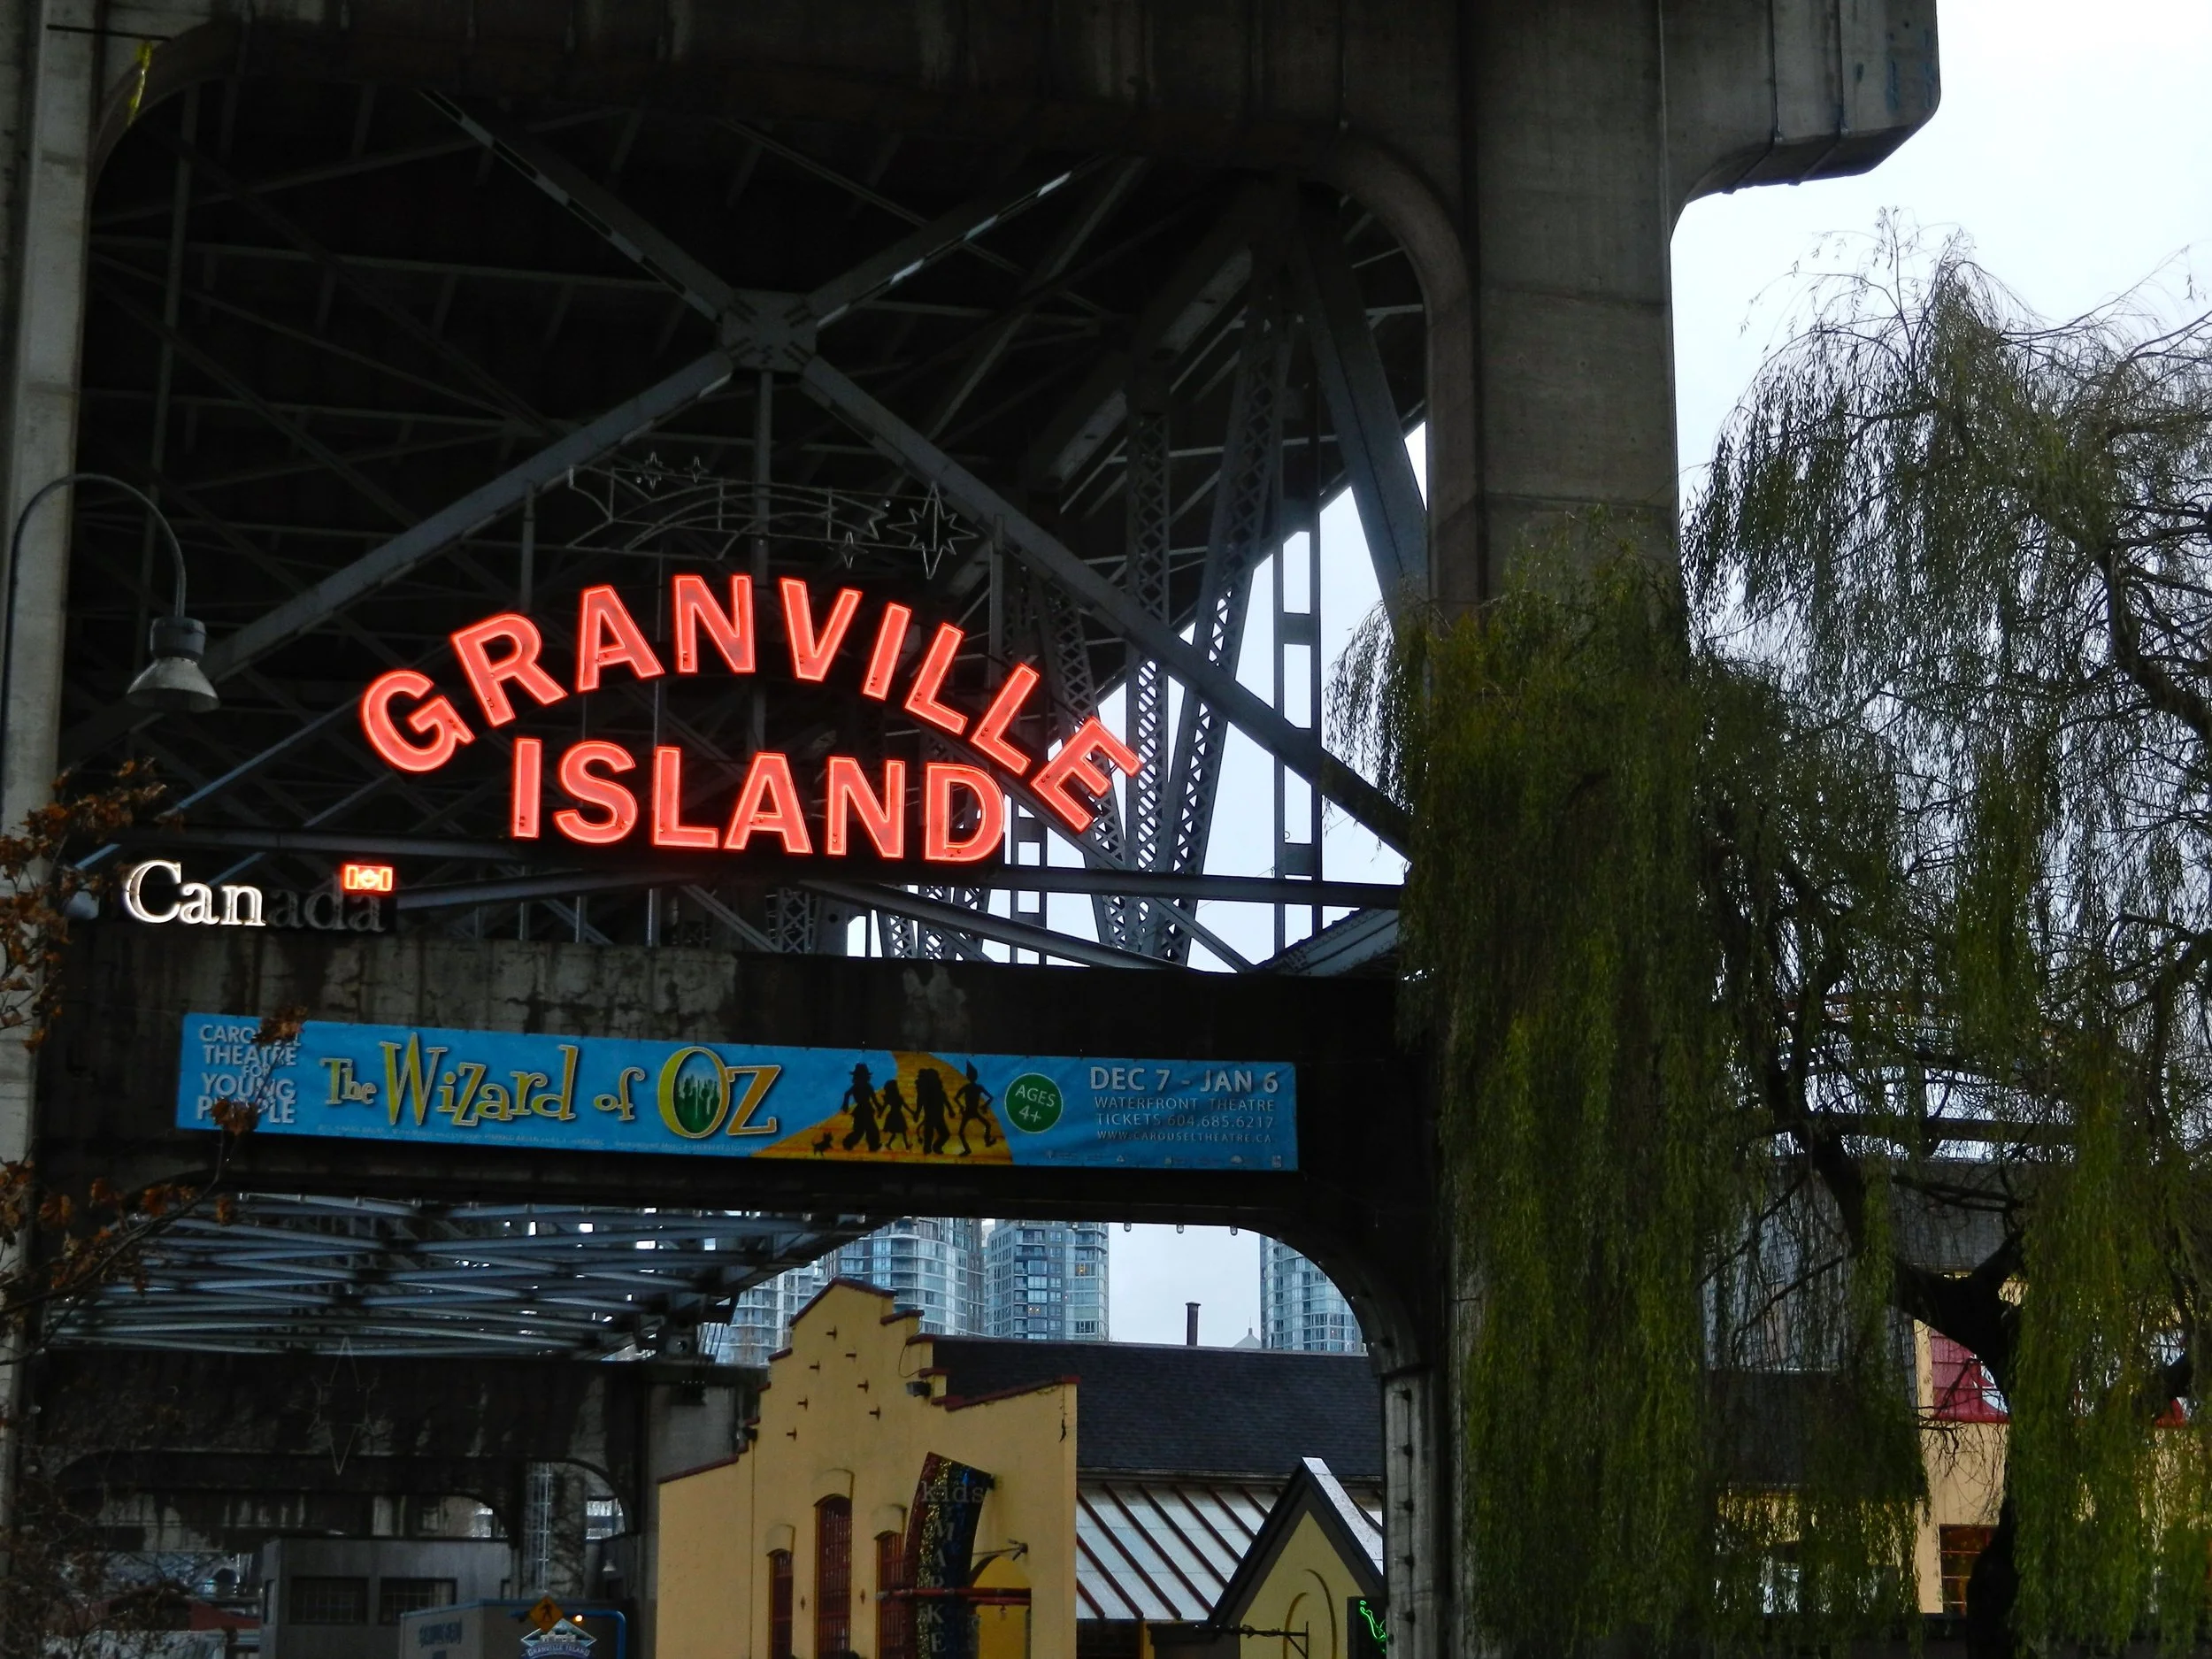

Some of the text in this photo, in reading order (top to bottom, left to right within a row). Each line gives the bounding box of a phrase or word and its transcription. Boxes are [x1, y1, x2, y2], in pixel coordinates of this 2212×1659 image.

[359, 574, 1143, 831] GRANVILLE
[510, 736, 1006, 862] ISLAND
[124, 859, 384, 932] Canada
[199, 1024, 301, 1046] CAROL
[202, 1043, 297, 1065] THEATRE
[242, 1063, 271, 1079] FOR
[319, 1057, 377, 1105] The
[380, 1032, 579, 1126] Wizard
[594, 1067, 645, 1121] of
[1090, 1066, 1146, 1091] DEC
[1156, 1069, 1171, 1091] 7
[1200, 1069, 1253, 1093] JAN
[1263, 1071, 1279, 1094] 6
[200, 1071, 296, 1099] YOUNG
[1015, 1084, 1056, 1108] AGES
[1018, 1104, 1041, 1123] 4+
[1094, 1096, 1275, 1112] WATERFRONT THEATRE
[1096, 1113, 1274, 1129] TICKETS 604.685.6217
[921, 1480, 985, 1504] kids
